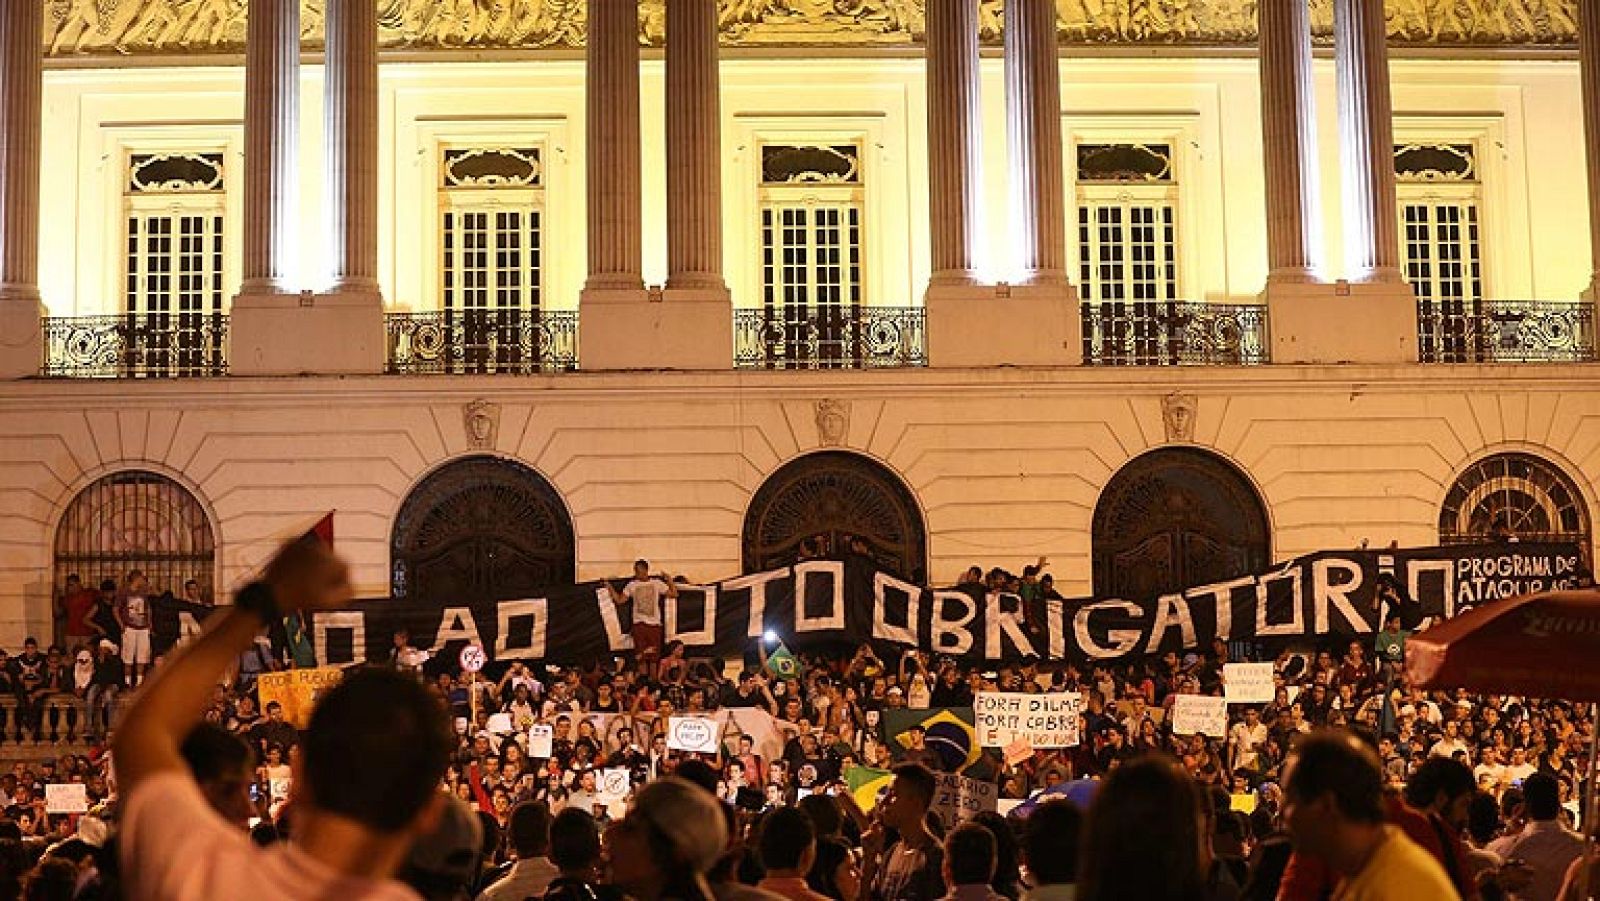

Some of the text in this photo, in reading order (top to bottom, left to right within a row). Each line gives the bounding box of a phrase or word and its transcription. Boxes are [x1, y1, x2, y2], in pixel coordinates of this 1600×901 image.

[1457, 554, 1552, 578] PROGRAMA
[426, 598, 548, 660] AO
[872, 556, 1455, 660] OBRIGATÓRIO
[977, 696, 1021, 711] FORA
[977, 712, 1020, 729] FORA
